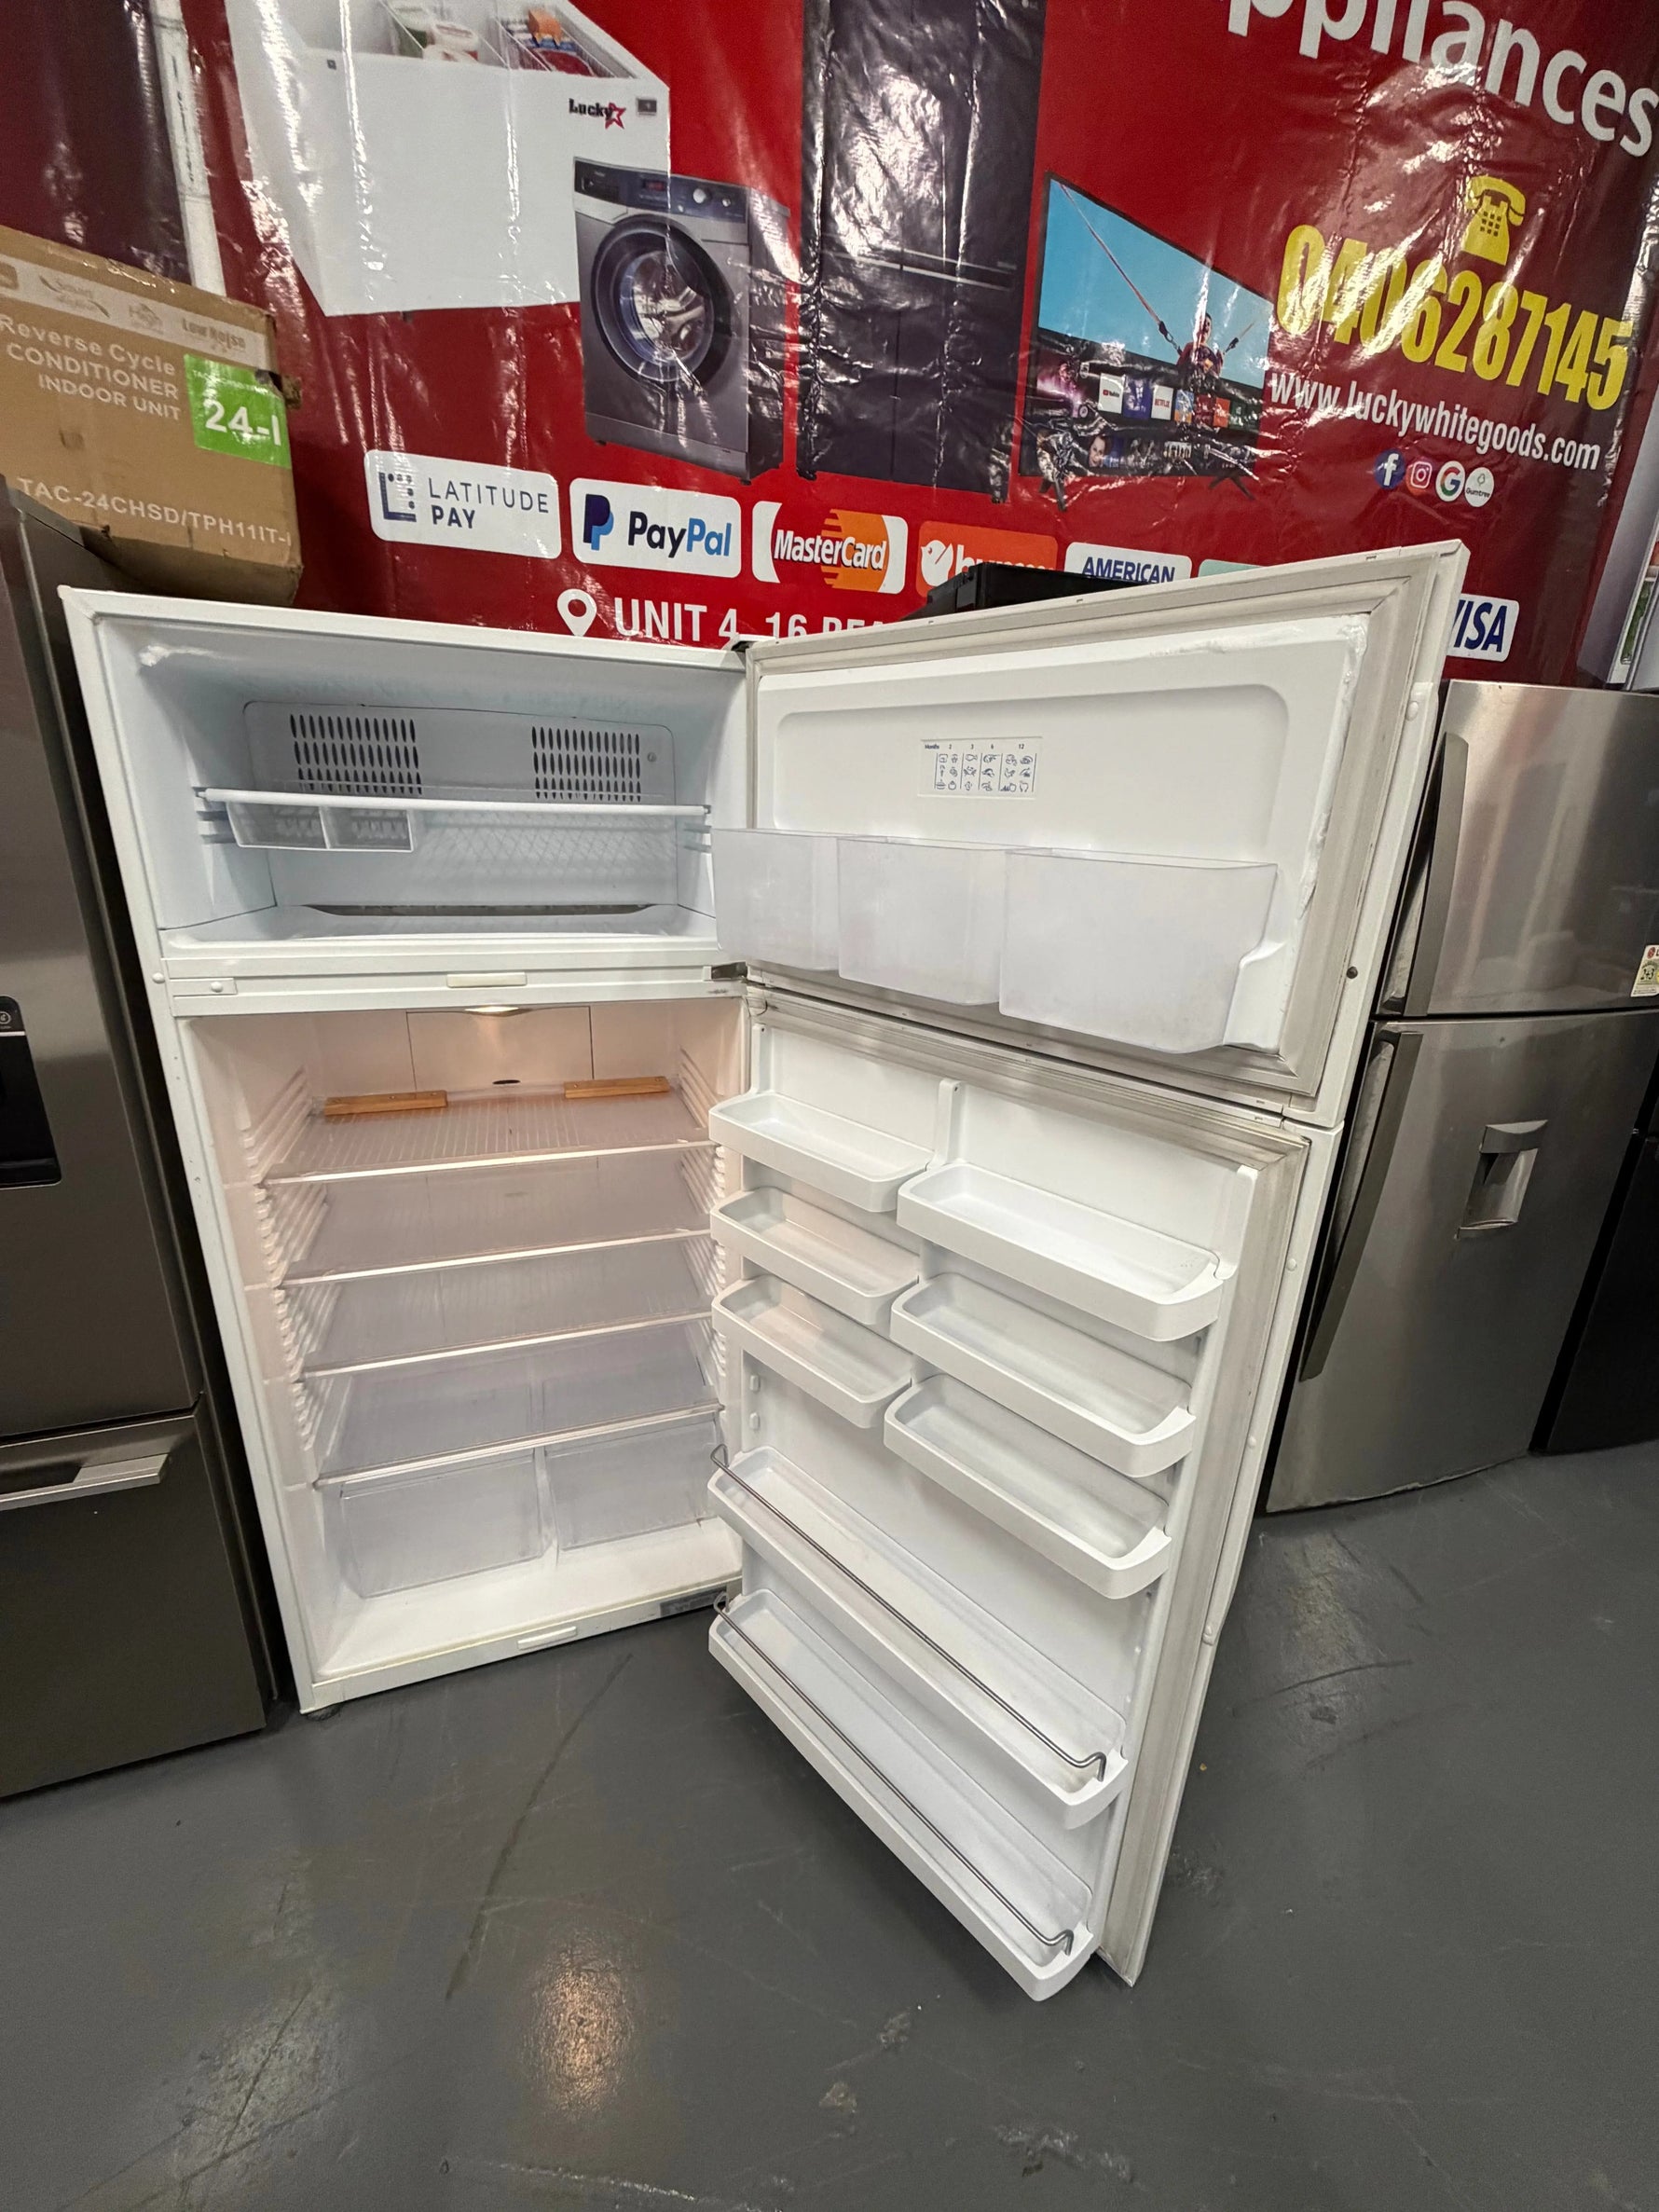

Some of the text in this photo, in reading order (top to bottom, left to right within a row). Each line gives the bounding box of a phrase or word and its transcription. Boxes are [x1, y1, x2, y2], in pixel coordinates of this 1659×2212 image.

[569, 98, 613, 120] Lucky
[1277, 225, 1633, 410] 0406287145
[0, 314, 103, 355] Reverse
[109, 343, 176, 376] Cycle
[7, 342, 180, 400] CONDITIONER
[39, 373, 182, 420] INDOOR UNIT
[429, 477, 549, 513] LATITUDE
[432, 504, 475, 529] PAY
[628, 511, 732, 558] PayPal
[774, 529, 887, 570] MasterCard
[1082, 556, 1175, 584] AMERICAN
[614, 598, 707, 641] UNIT
[719, 608, 738, 639] 4
